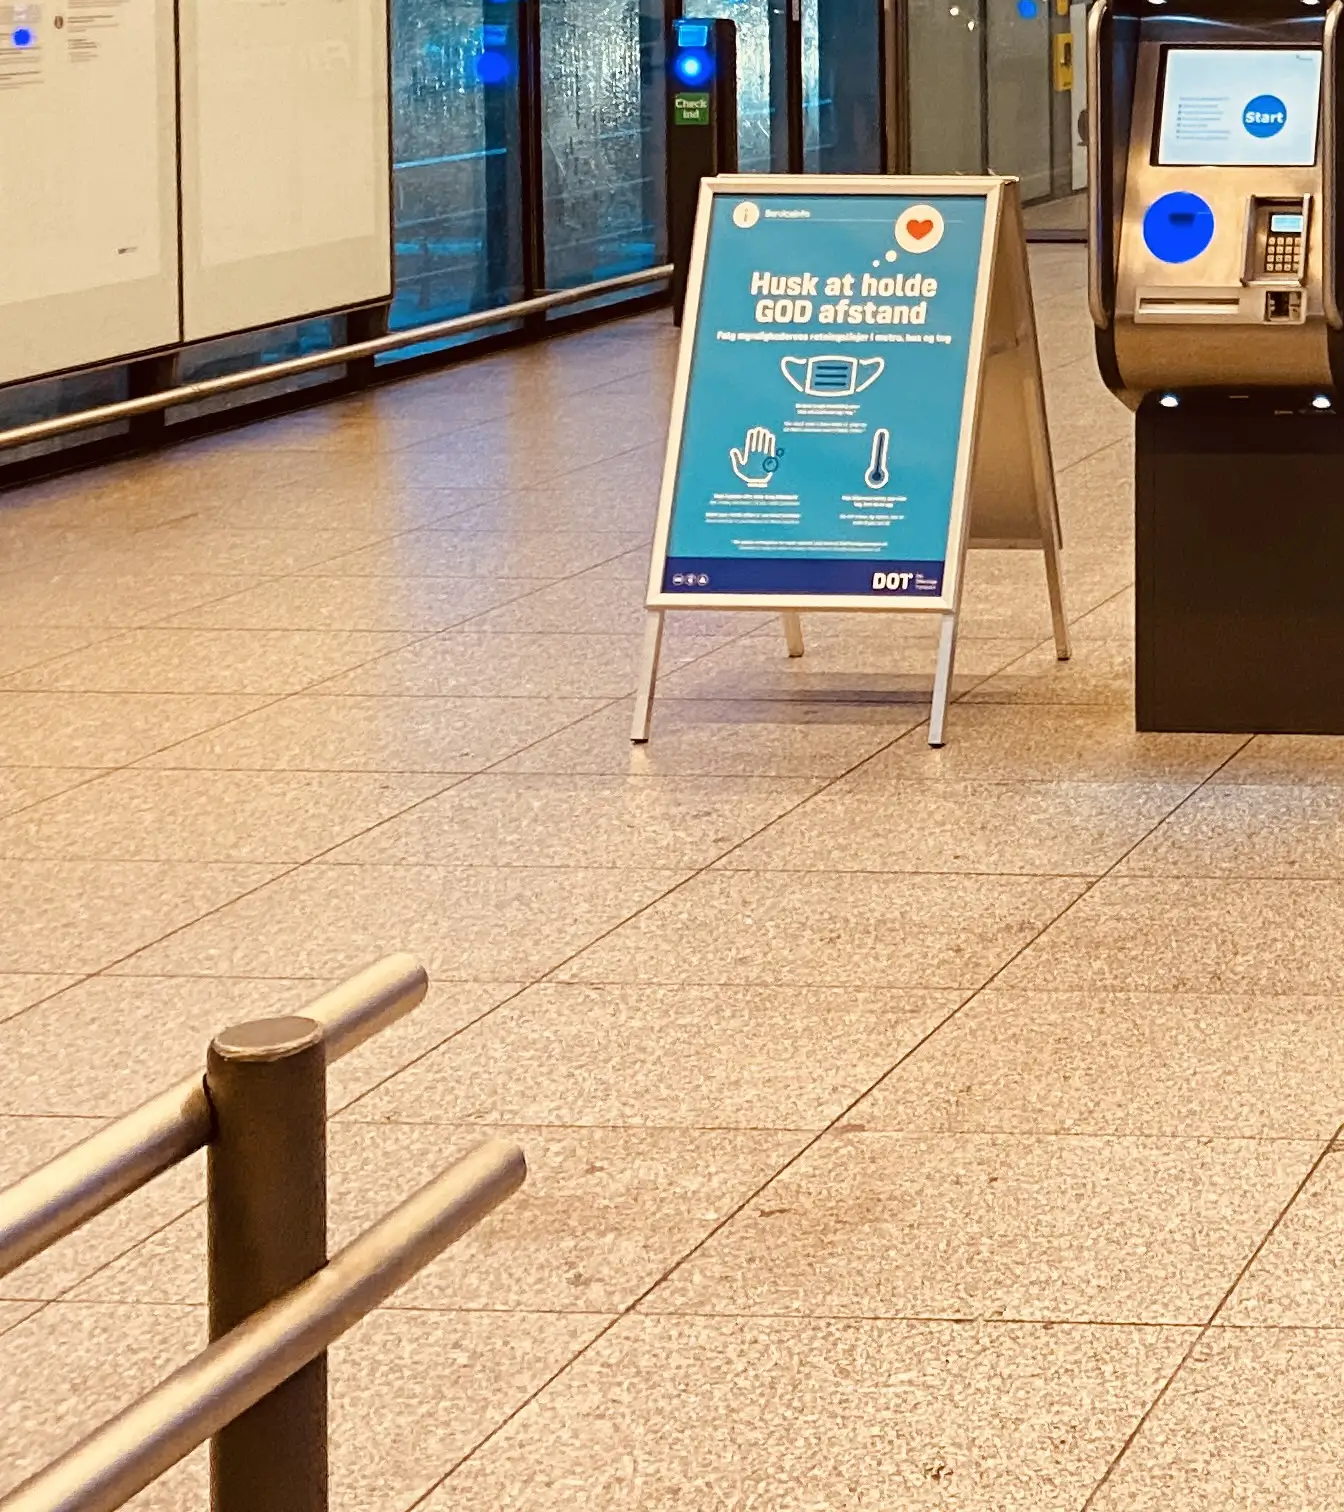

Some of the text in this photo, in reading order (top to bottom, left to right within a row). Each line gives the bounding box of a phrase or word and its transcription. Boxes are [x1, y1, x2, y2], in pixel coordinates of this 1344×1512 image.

[675, 98, 707, 108] Check
[683, 109, 699, 119] ind
[1245, 111, 1285, 124] Start
[751, 271, 938, 297] Husk at holde
[755, 299, 927, 325] GOD afstand
[873, 572, 914, 590] DOT
